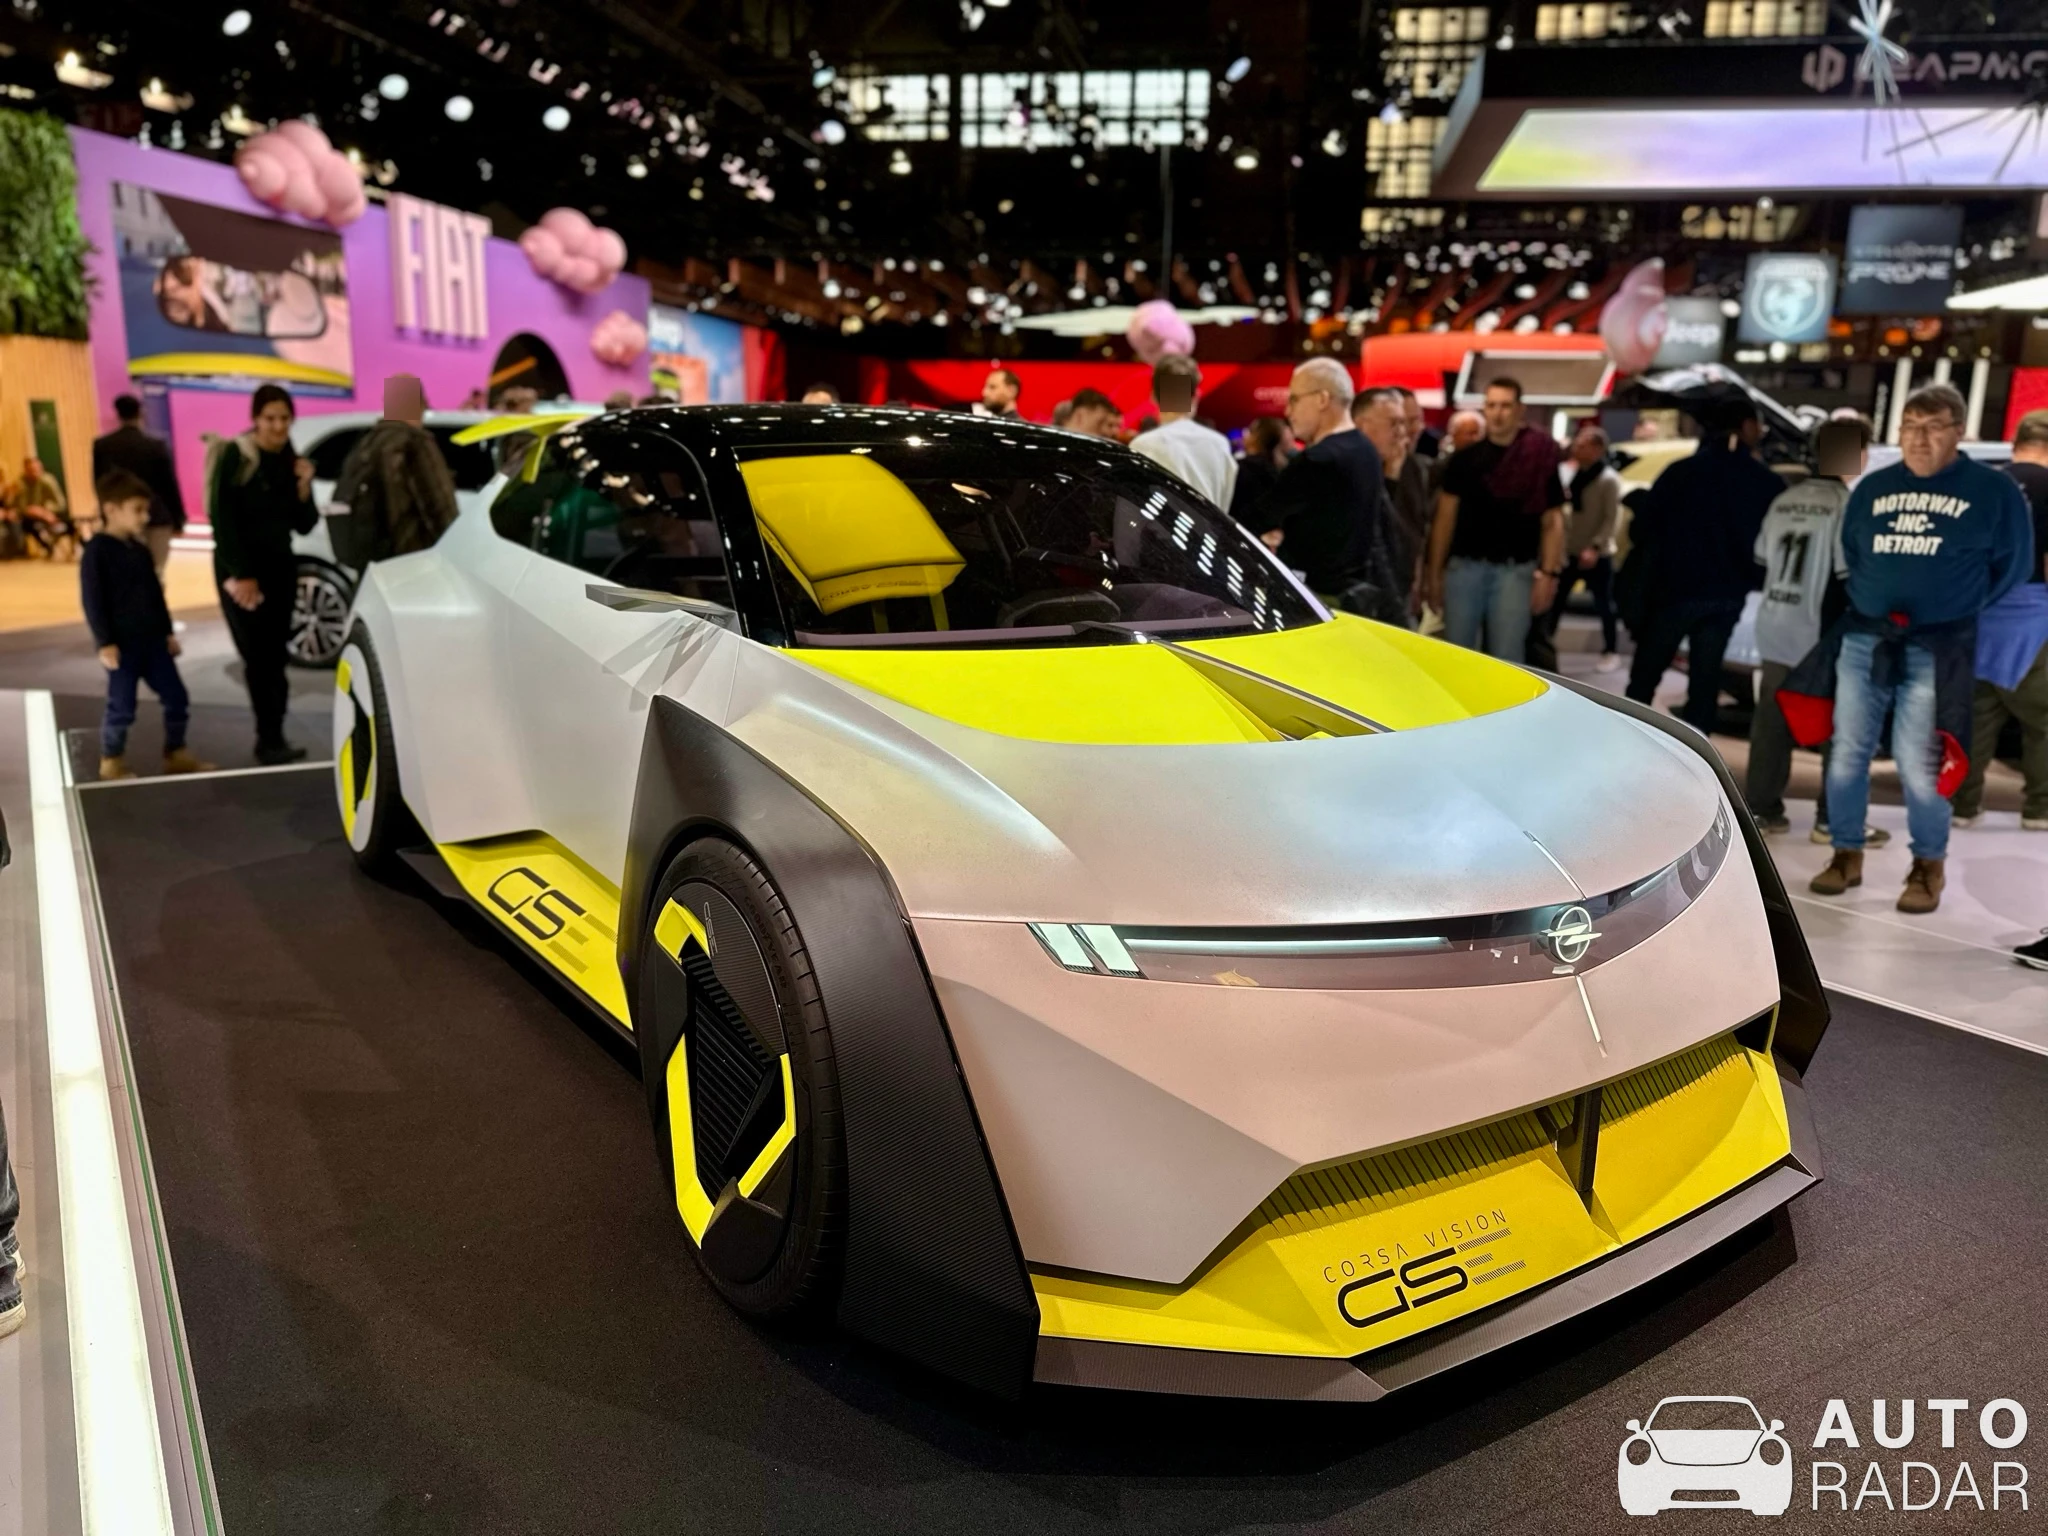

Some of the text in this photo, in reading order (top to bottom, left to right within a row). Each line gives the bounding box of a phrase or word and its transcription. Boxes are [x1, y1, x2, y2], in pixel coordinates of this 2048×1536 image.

[386, 191, 492, 339] FIAT
[1872, 491, 1971, 519] MOTORWAY
[1780, 531, 1811, 583] 11
[1872, 534, 1943, 556] DETROIT
[1323, 1208, 1507, 1284] CORSA VISION
